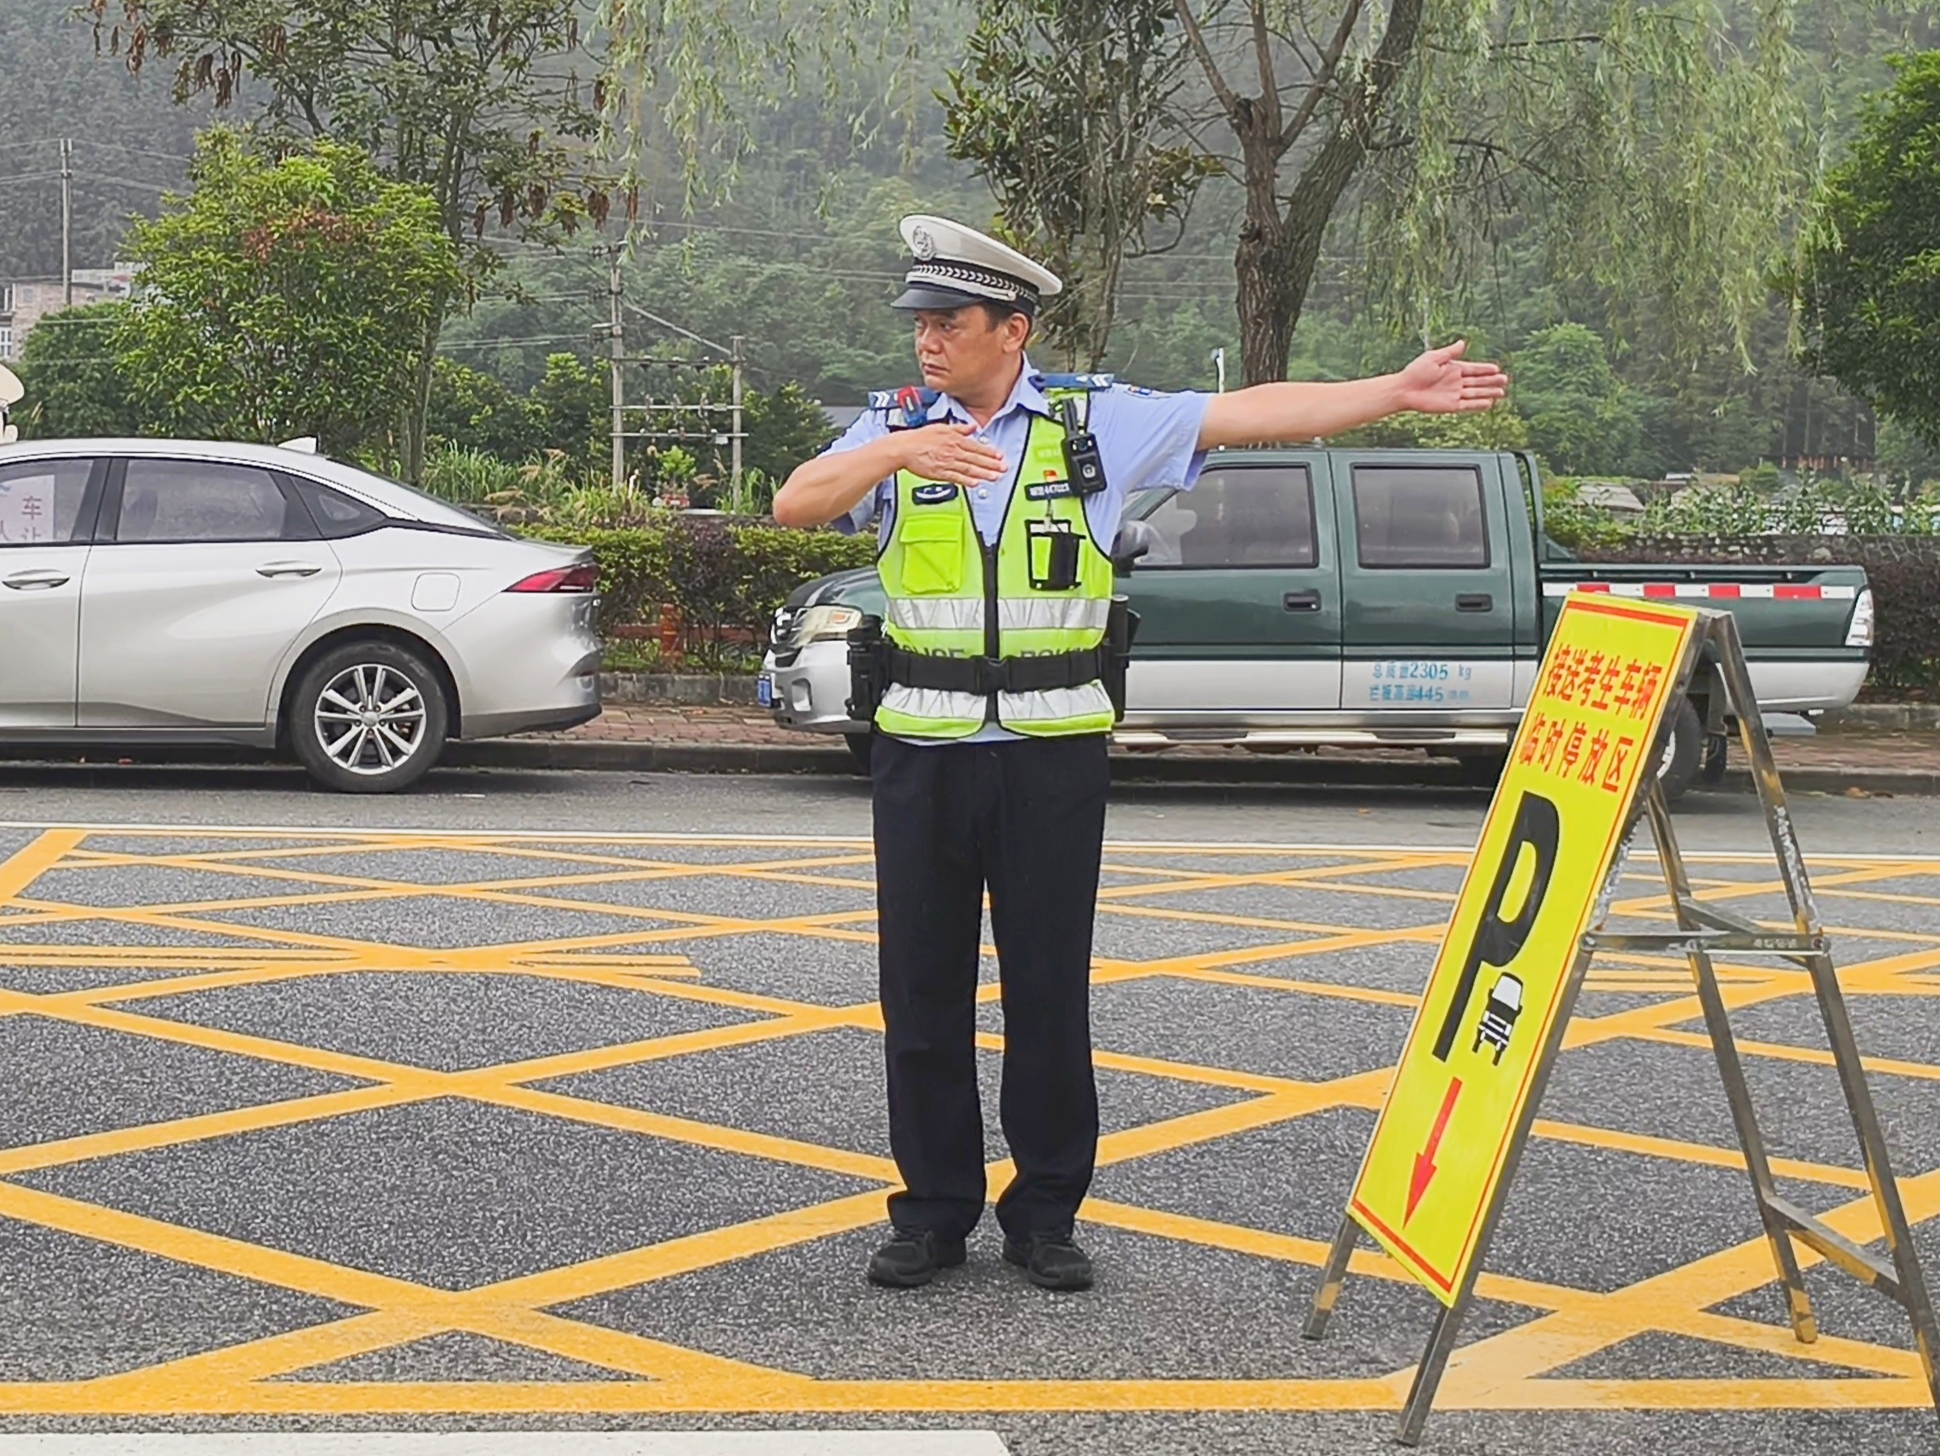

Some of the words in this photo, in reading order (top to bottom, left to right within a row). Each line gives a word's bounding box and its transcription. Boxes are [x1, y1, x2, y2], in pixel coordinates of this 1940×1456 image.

[1543, 642, 1662, 720] 接送考生车辆
[1518, 711, 1634, 793] 临时停放区
[1432, 790, 1560, 1063] P
